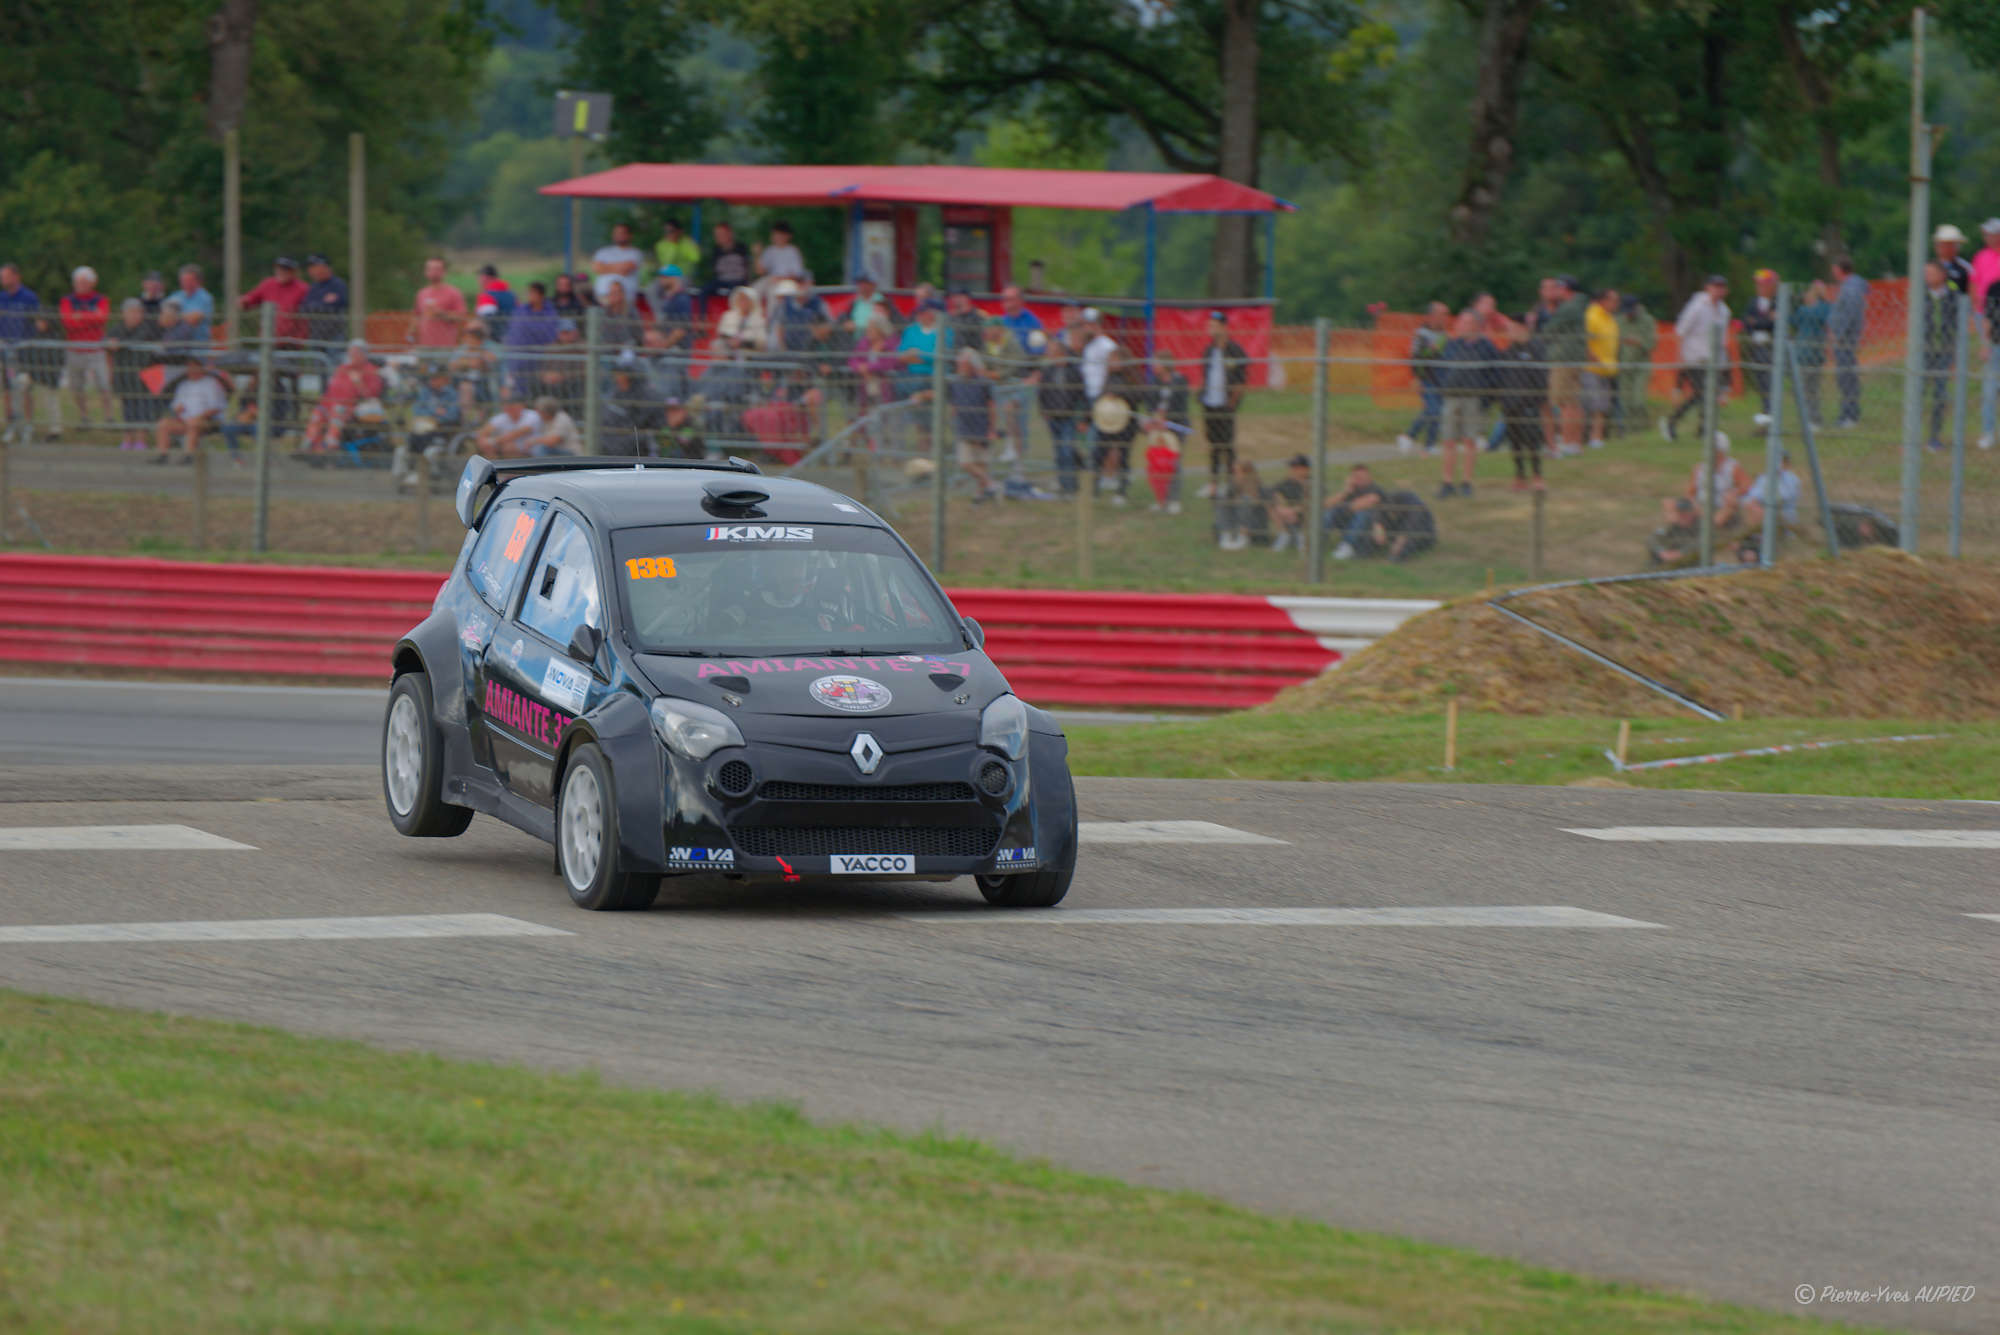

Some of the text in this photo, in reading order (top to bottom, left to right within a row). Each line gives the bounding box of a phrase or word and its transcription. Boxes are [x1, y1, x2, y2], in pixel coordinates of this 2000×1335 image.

[717, 526, 814, 540] KMS
[625, 557, 677, 580] 138
[697, 657, 970, 678] AMIANTE 37
[485, 679, 551, 745] AMIANTE
[840, 857, 907, 871] YACCO
